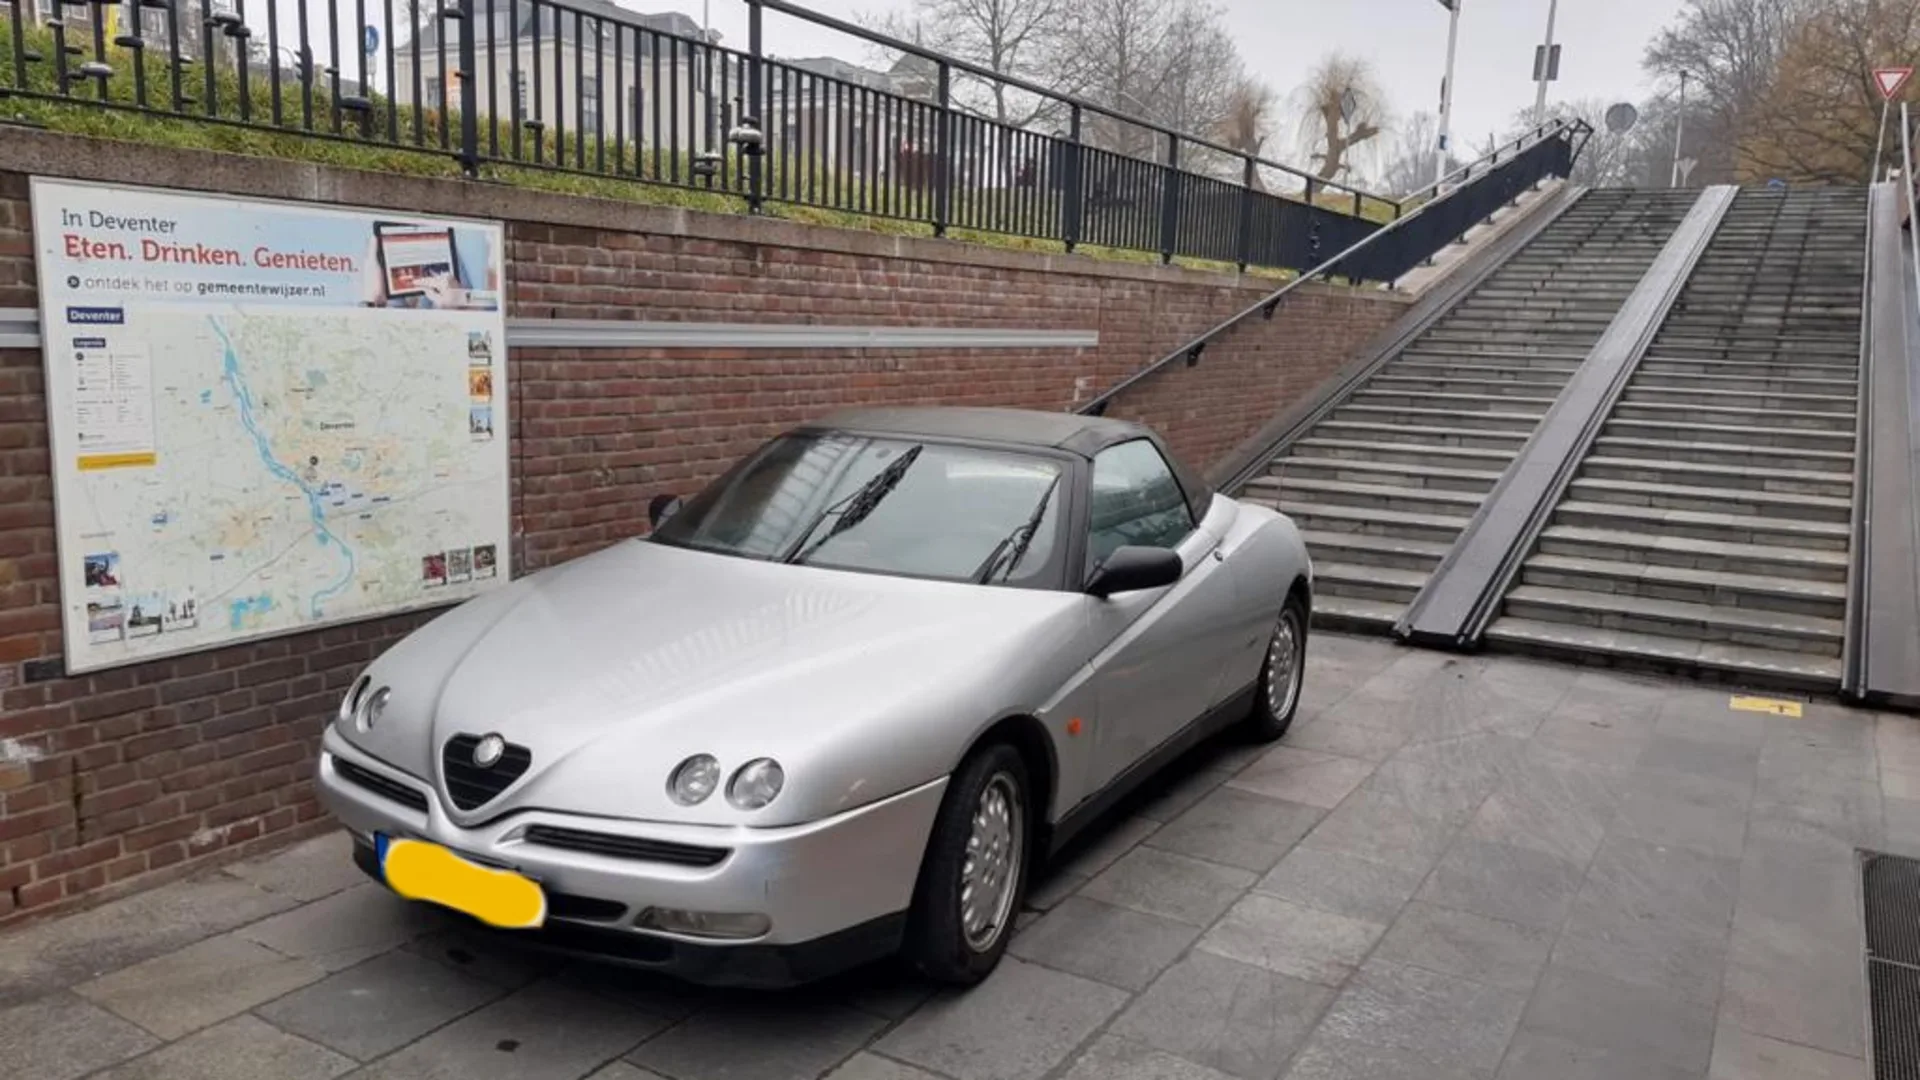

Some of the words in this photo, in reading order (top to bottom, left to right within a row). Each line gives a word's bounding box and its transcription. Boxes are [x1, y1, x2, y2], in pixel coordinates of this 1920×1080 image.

[62, 208, 82, 226] In
[89, 210, 177, 233] Deventer
[64, 234, 132, 260] Eten.
[142, 239, 247, 267] Drinken.
[254, 246, 358, 273] Genieten.
[85, 277, 139, 291] ontdek
[145, 279, 168, 292] het
[174, 282, 192, 294] op
[197, 281, 326, 299] gemeentewijzer.nl
[70, 310, 121, 321] Deventer
